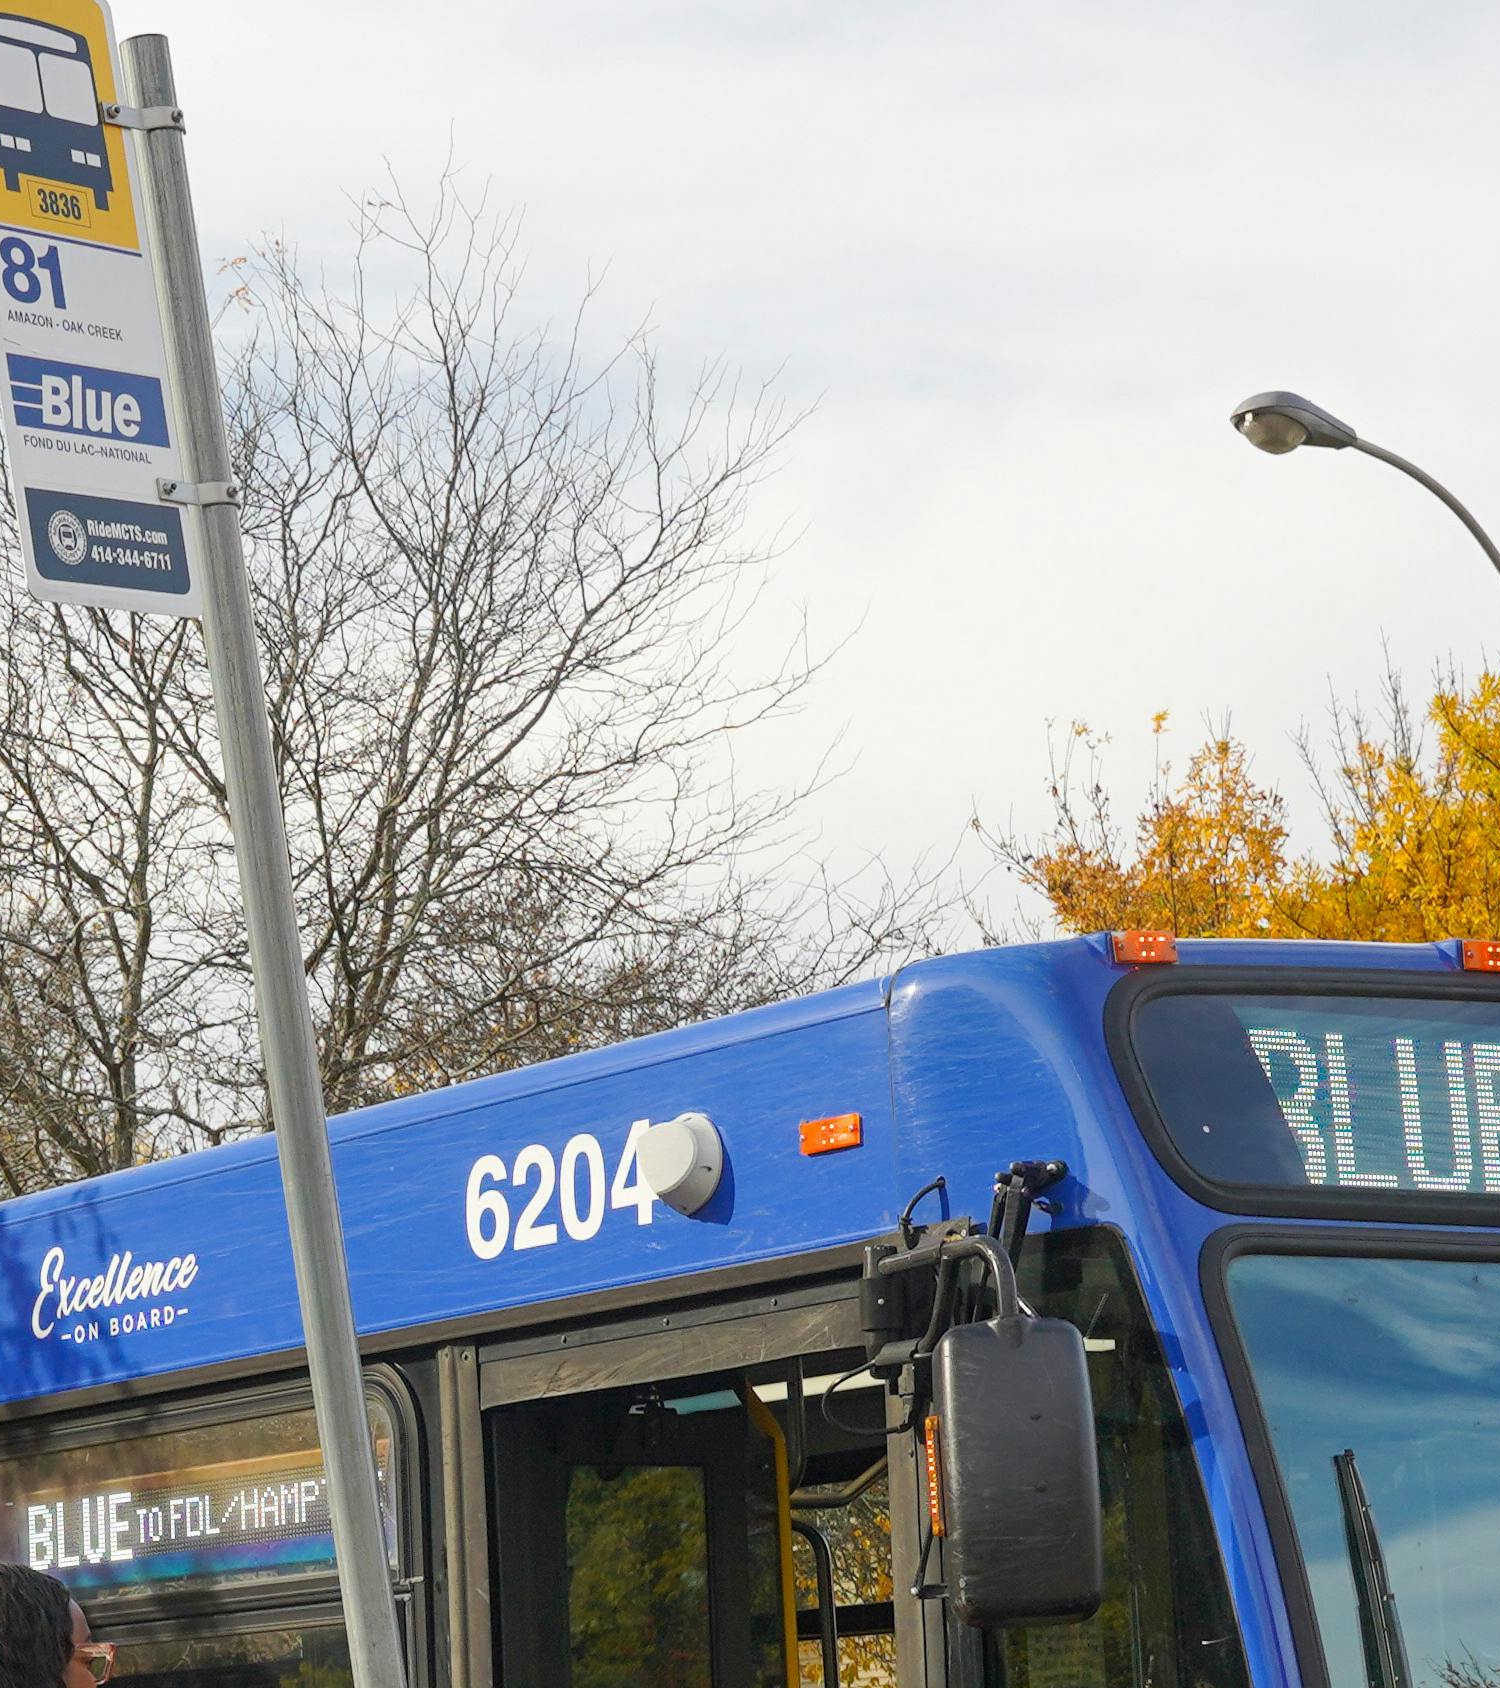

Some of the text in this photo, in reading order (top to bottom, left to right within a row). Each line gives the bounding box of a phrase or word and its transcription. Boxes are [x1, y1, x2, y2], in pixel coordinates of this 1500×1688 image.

[37, 188, 82, 220] 3836
[0, 236, 67, 310] 81
[7, 309, 53, 329] AMAZON
[62, 319, 85, 335] OAK
[87, 323, 124, 342] CREEK
[41, 374, 141, 438] Blue
[23, 434, 54, 450] FOND
[56, 439, 71, 453] DU
[86, 519, 169, 546] RideMCTS.com
[90, 544, 172, 571] 414-344-6711
[465, 1118, 660, 1260] 6204
[31, 1246, 199, 1340] Excellence
[27, 1492, 133, 1571] BLUE
[169, 1471, 383, 1540] FDL/HAMP
